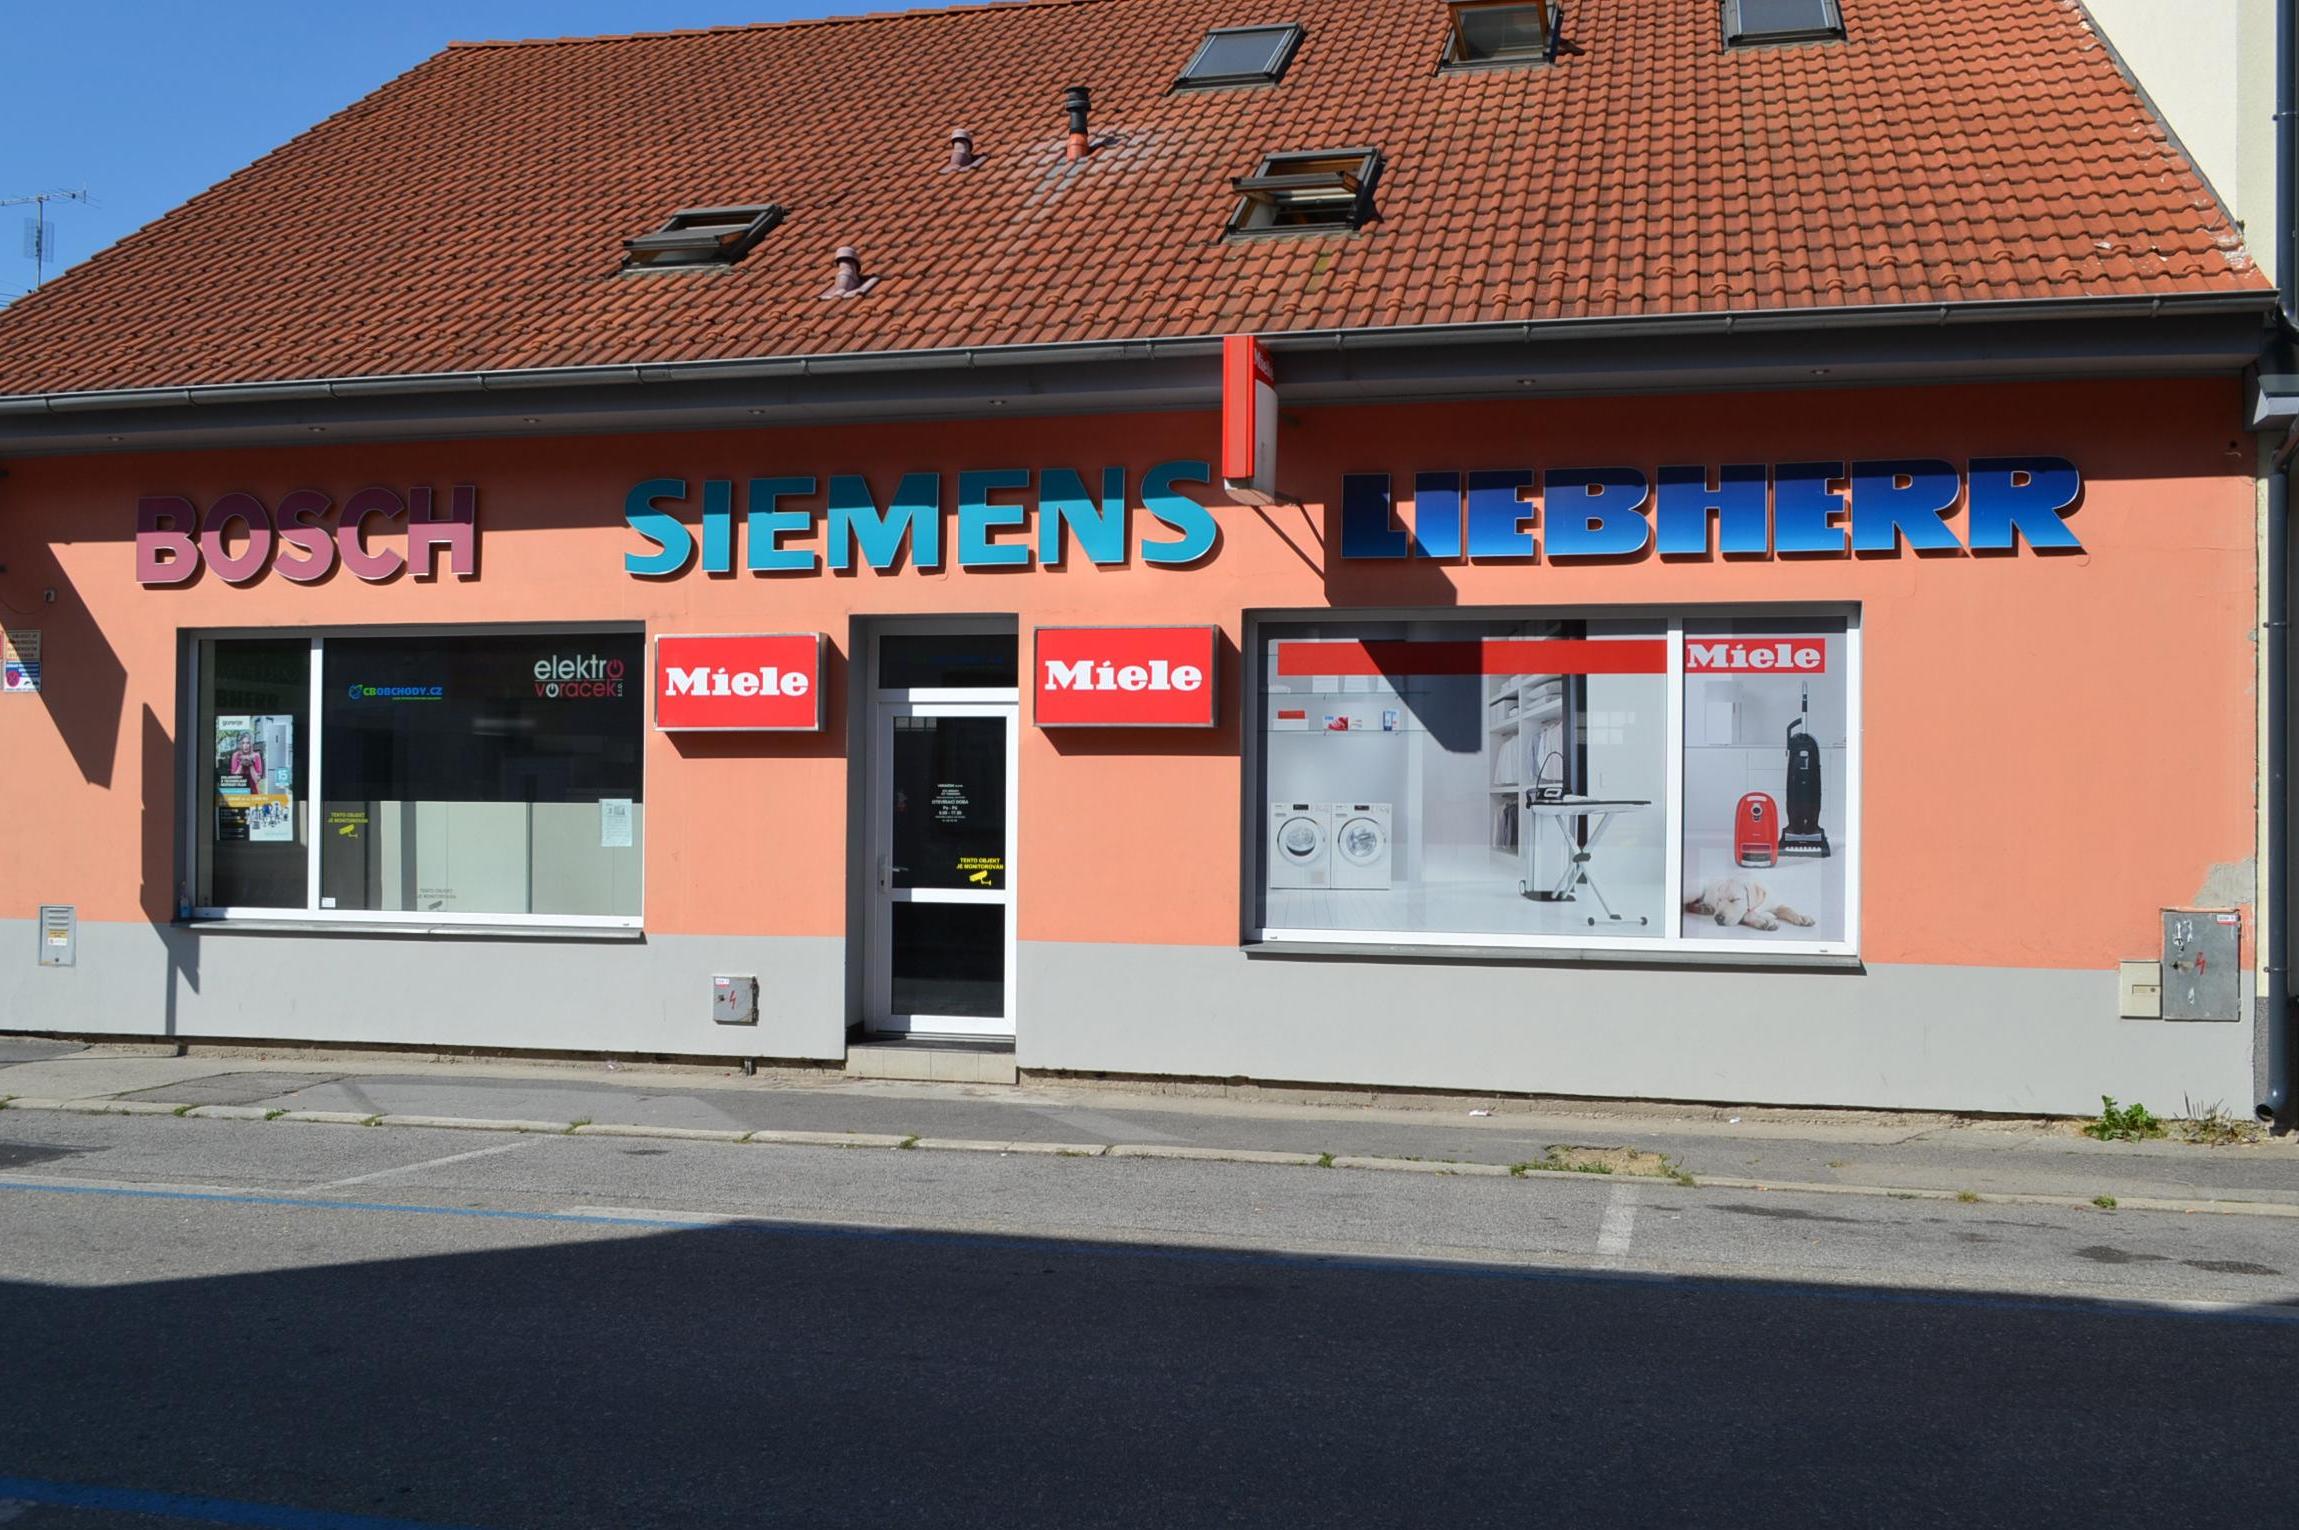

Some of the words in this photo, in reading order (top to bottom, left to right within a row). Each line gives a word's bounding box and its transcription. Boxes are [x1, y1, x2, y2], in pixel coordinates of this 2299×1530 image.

[624, 460, 1217, 577] SIEMENS
[1341, 455, 2084, 559] LIEBHERR
[135, 485, 476, 584] BOSCH
[533, 654, 624, 680] elektro
[1685, 641, 1823, 670] Miele
[664, 665, 809, 697] Miele
[1043, 658, 1204, 692] Miele
